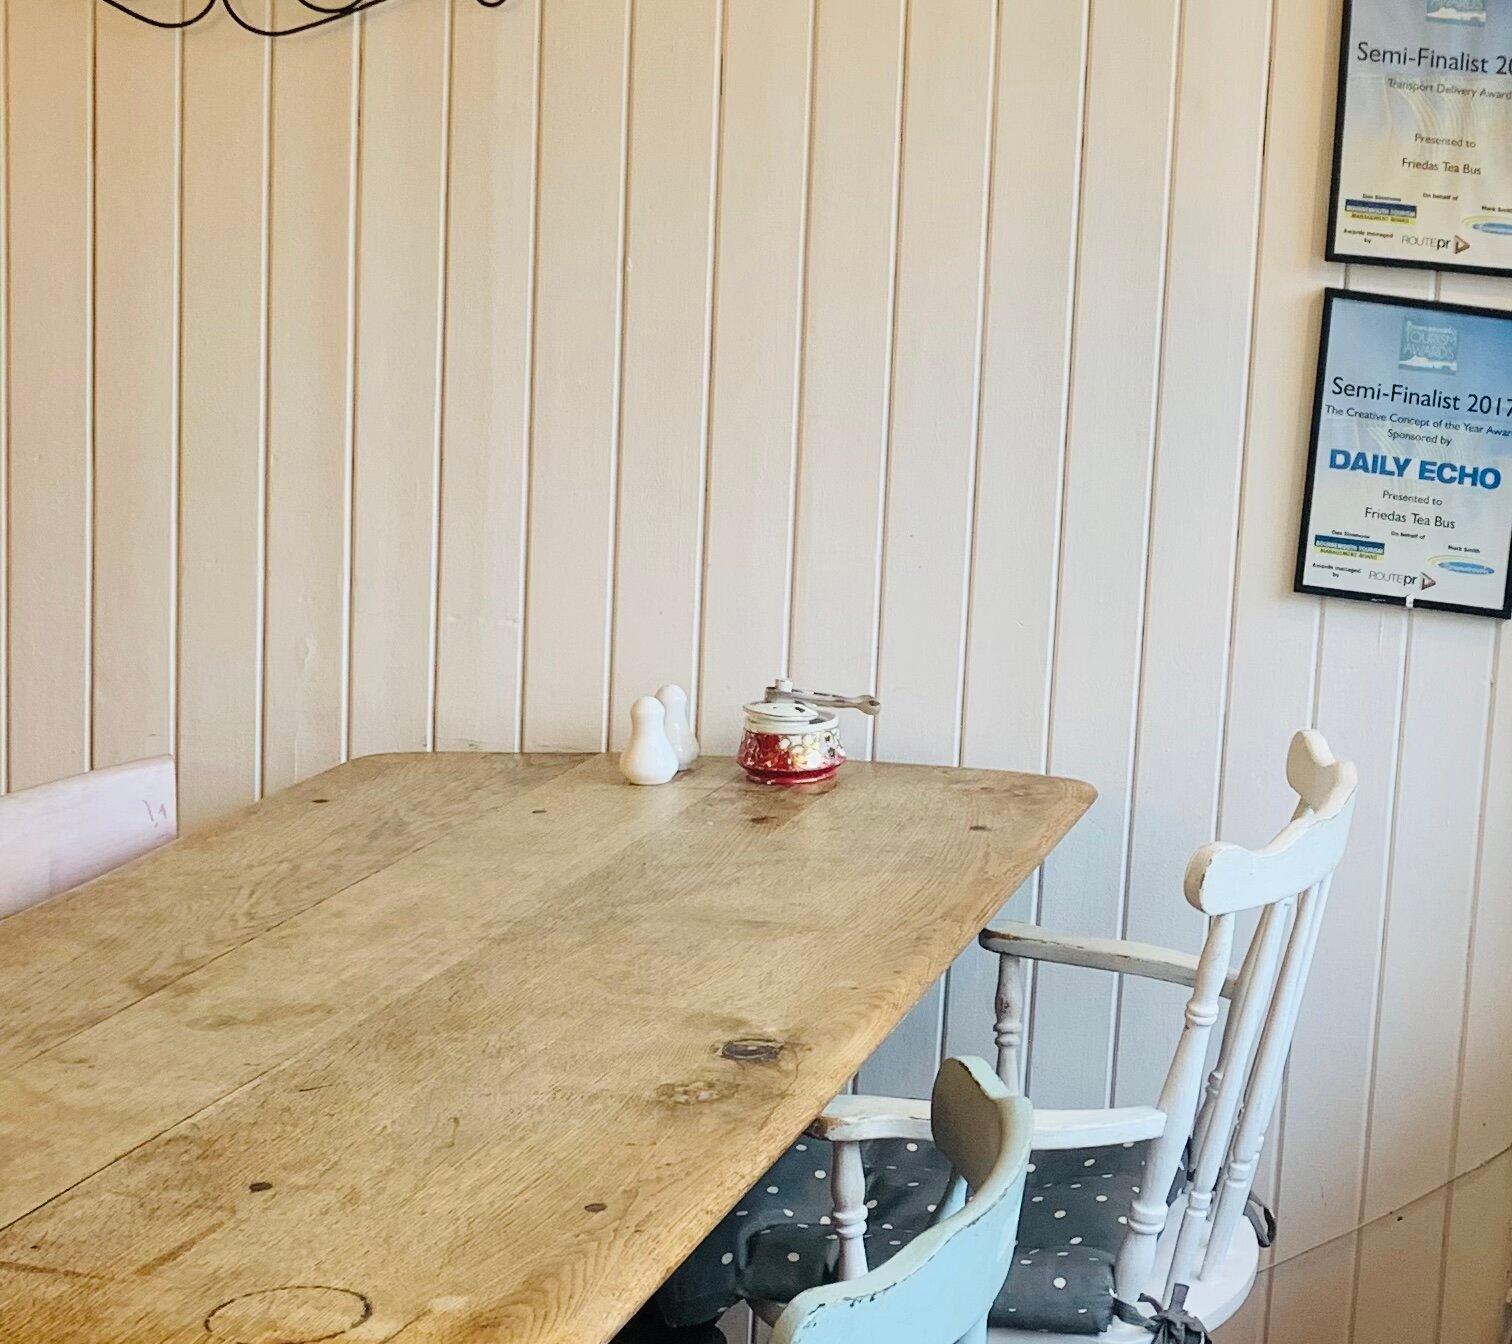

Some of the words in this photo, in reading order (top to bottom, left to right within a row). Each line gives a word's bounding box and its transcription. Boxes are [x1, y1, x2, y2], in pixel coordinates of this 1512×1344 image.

[1358, 41, 1489, 73] Semi-Finalist
[1387, 78, 1433, 93] Transport
[1437, 83, 1477, 97] Delivery
[1480, 88, 1512, 100] Award
[1415, 133, 1462, 148] Presented
[1465, 140, 1476, 148] to
[1402, 157, 1439, 171] Friedas
[1443, 162, 1459, 172] Tea
[1463, 164, 1481, 175] Bus
[1401, 235, 1451, 250] ROUTEpr
[1331, 376, 1461, 411] Semi-Finalist
[1325, 405, 1343, 416] The
[1347, 408, 1387, 421] Creative
[1390, 414, 1429, 427] Concept
[1433, 420, 1443, 428] of
[1463, 423, 1483, 433] Year
[1387, 429, 1438, 444] Sponsored
[1440, 436, 1452, 446] by
[1329, 449, 1411, 477] DAILY
[1419, 460, 1501, 490] ECHO
[1382, 490, 1430, 504] Presented
[1432, 498, 1443, 506] to
[1365, 507, 1406, 523] Friedas
[1410, 513, 1430, 526] Tea
[1434, 516, 1456, 529] Bus
[1369, 570, 1417, 586] ROUTEpr
